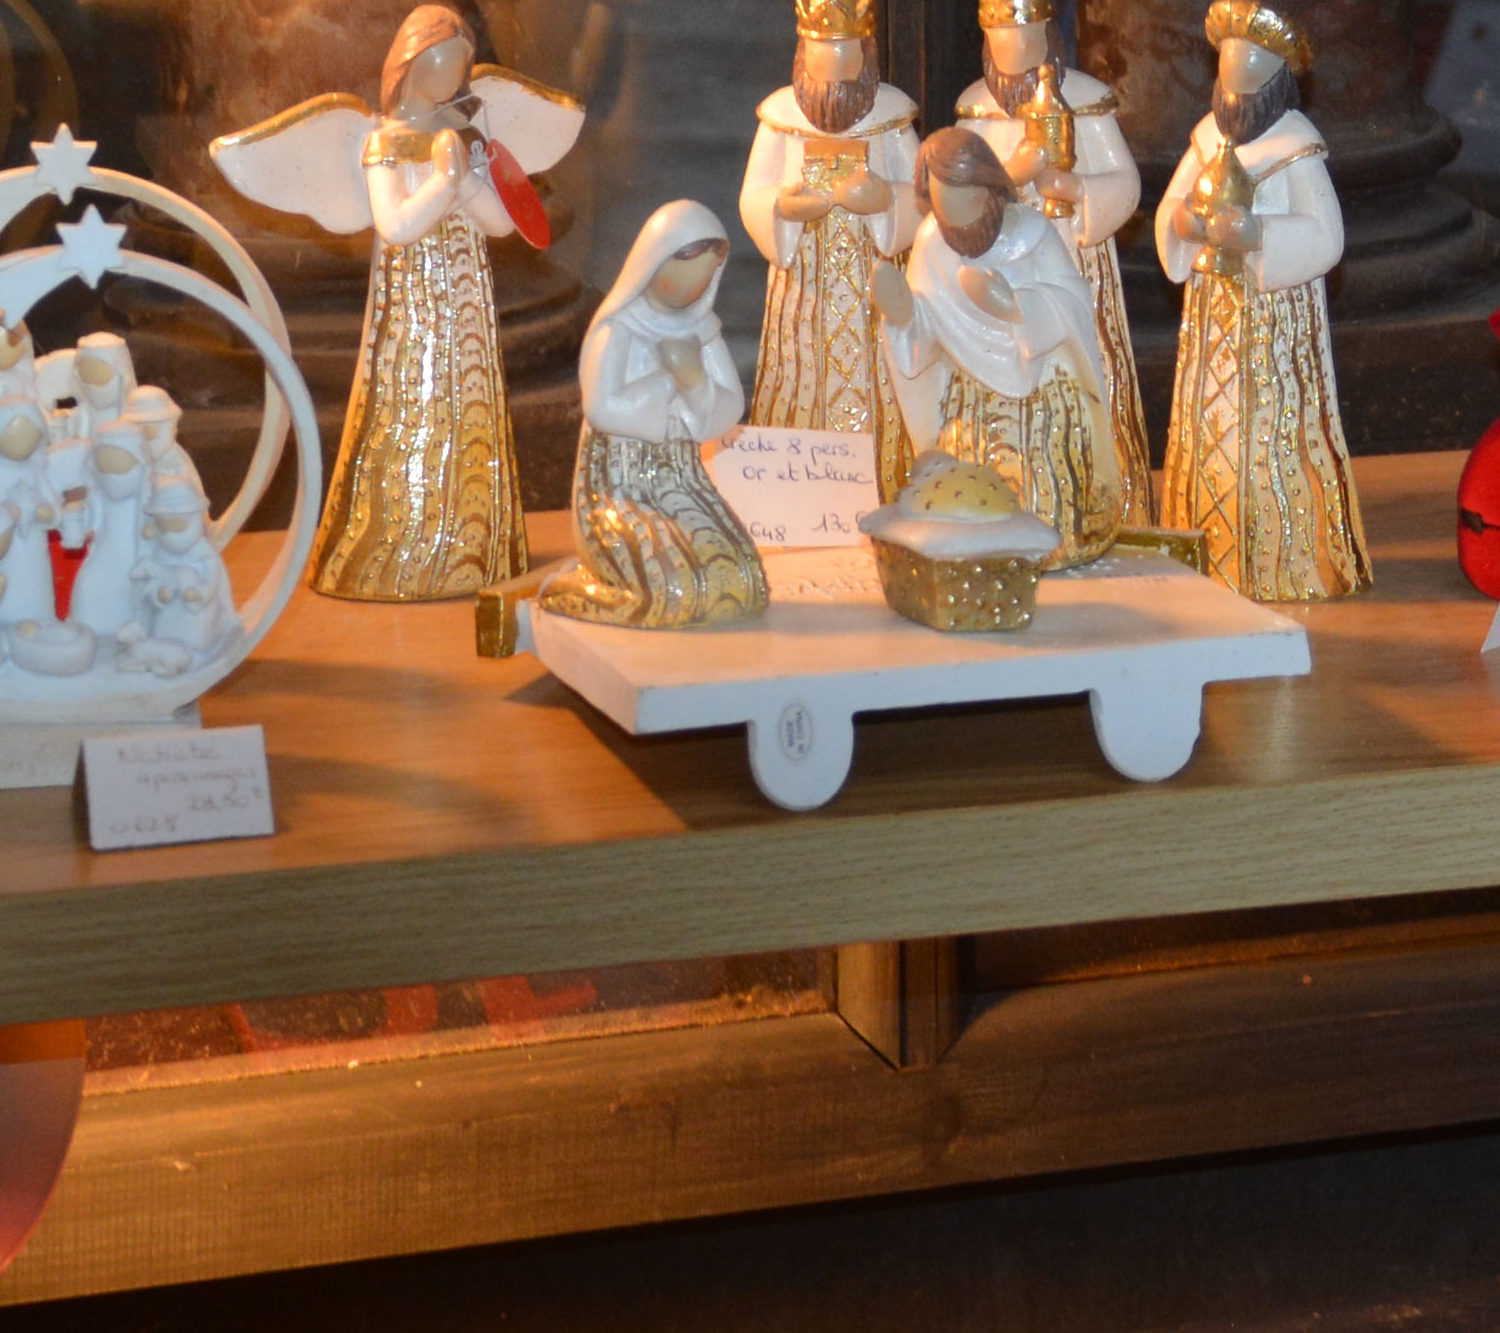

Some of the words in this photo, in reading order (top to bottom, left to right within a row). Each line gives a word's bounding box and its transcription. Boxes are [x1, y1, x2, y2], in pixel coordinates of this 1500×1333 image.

[787, 438, 801, 455] 8
[810, 444, 856, 467] pers.
[777, 462, 800, 482] et
[805, 464, 875, 484] blanc
